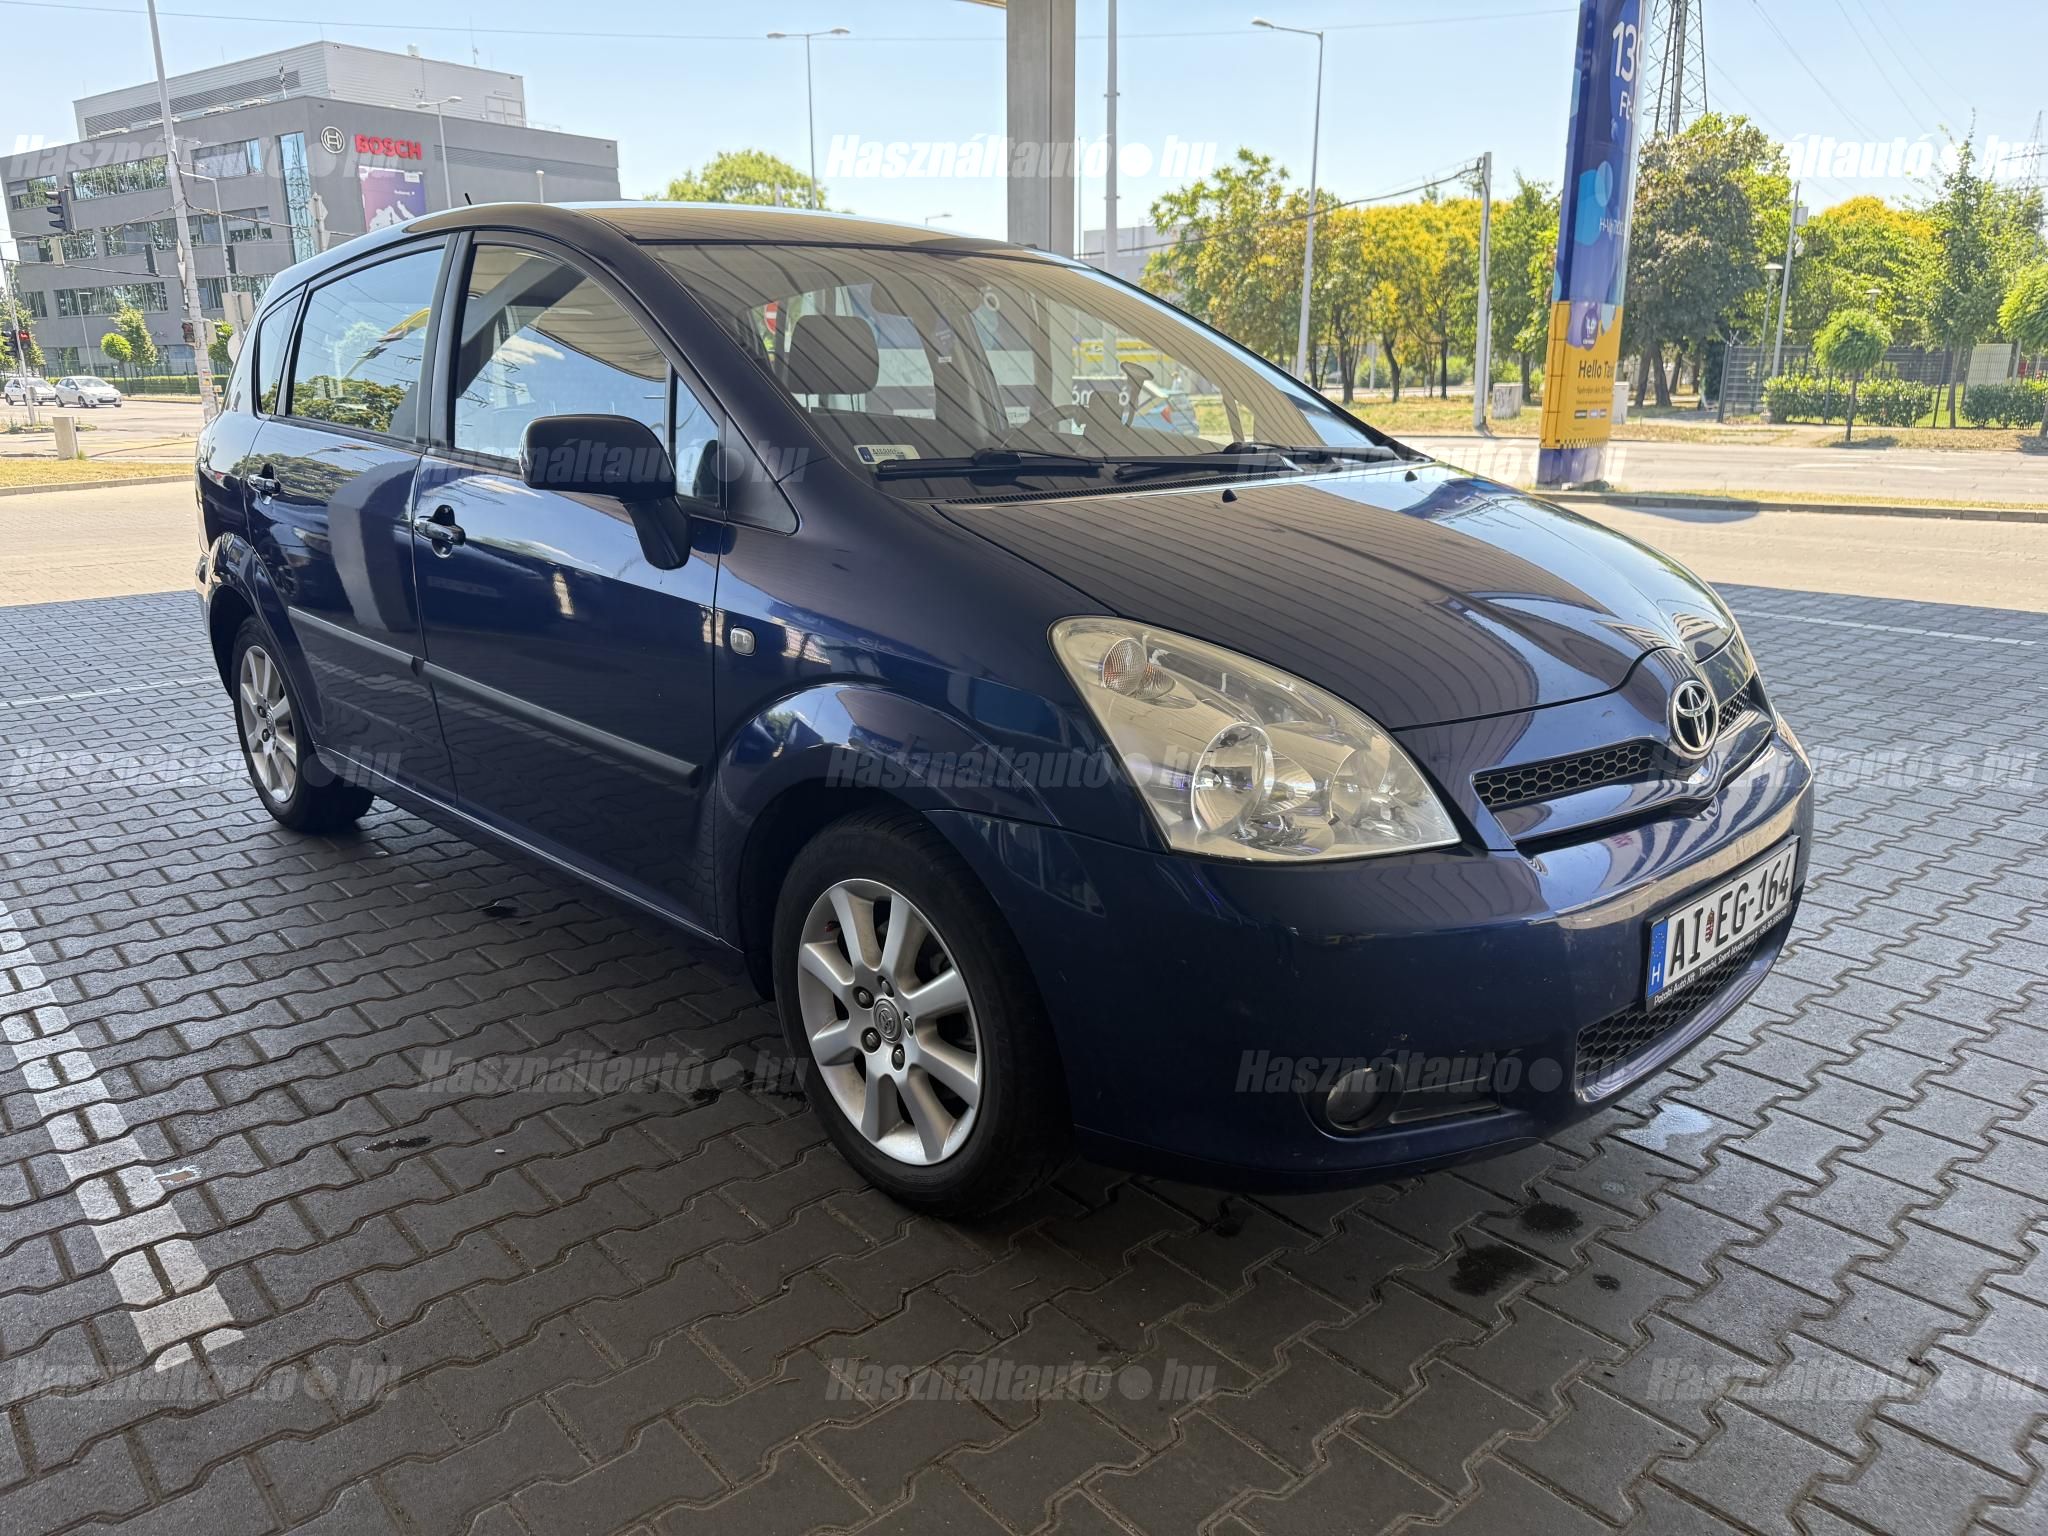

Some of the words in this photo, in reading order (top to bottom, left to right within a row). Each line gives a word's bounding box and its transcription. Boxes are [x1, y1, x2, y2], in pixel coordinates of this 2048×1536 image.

[354, 133, 423, 160] BOSCH
[1577, 360, 1602, 379] Hello
[1714, 853, 1792, 949] EG-164
[1651, 962, 1661, 986] H
